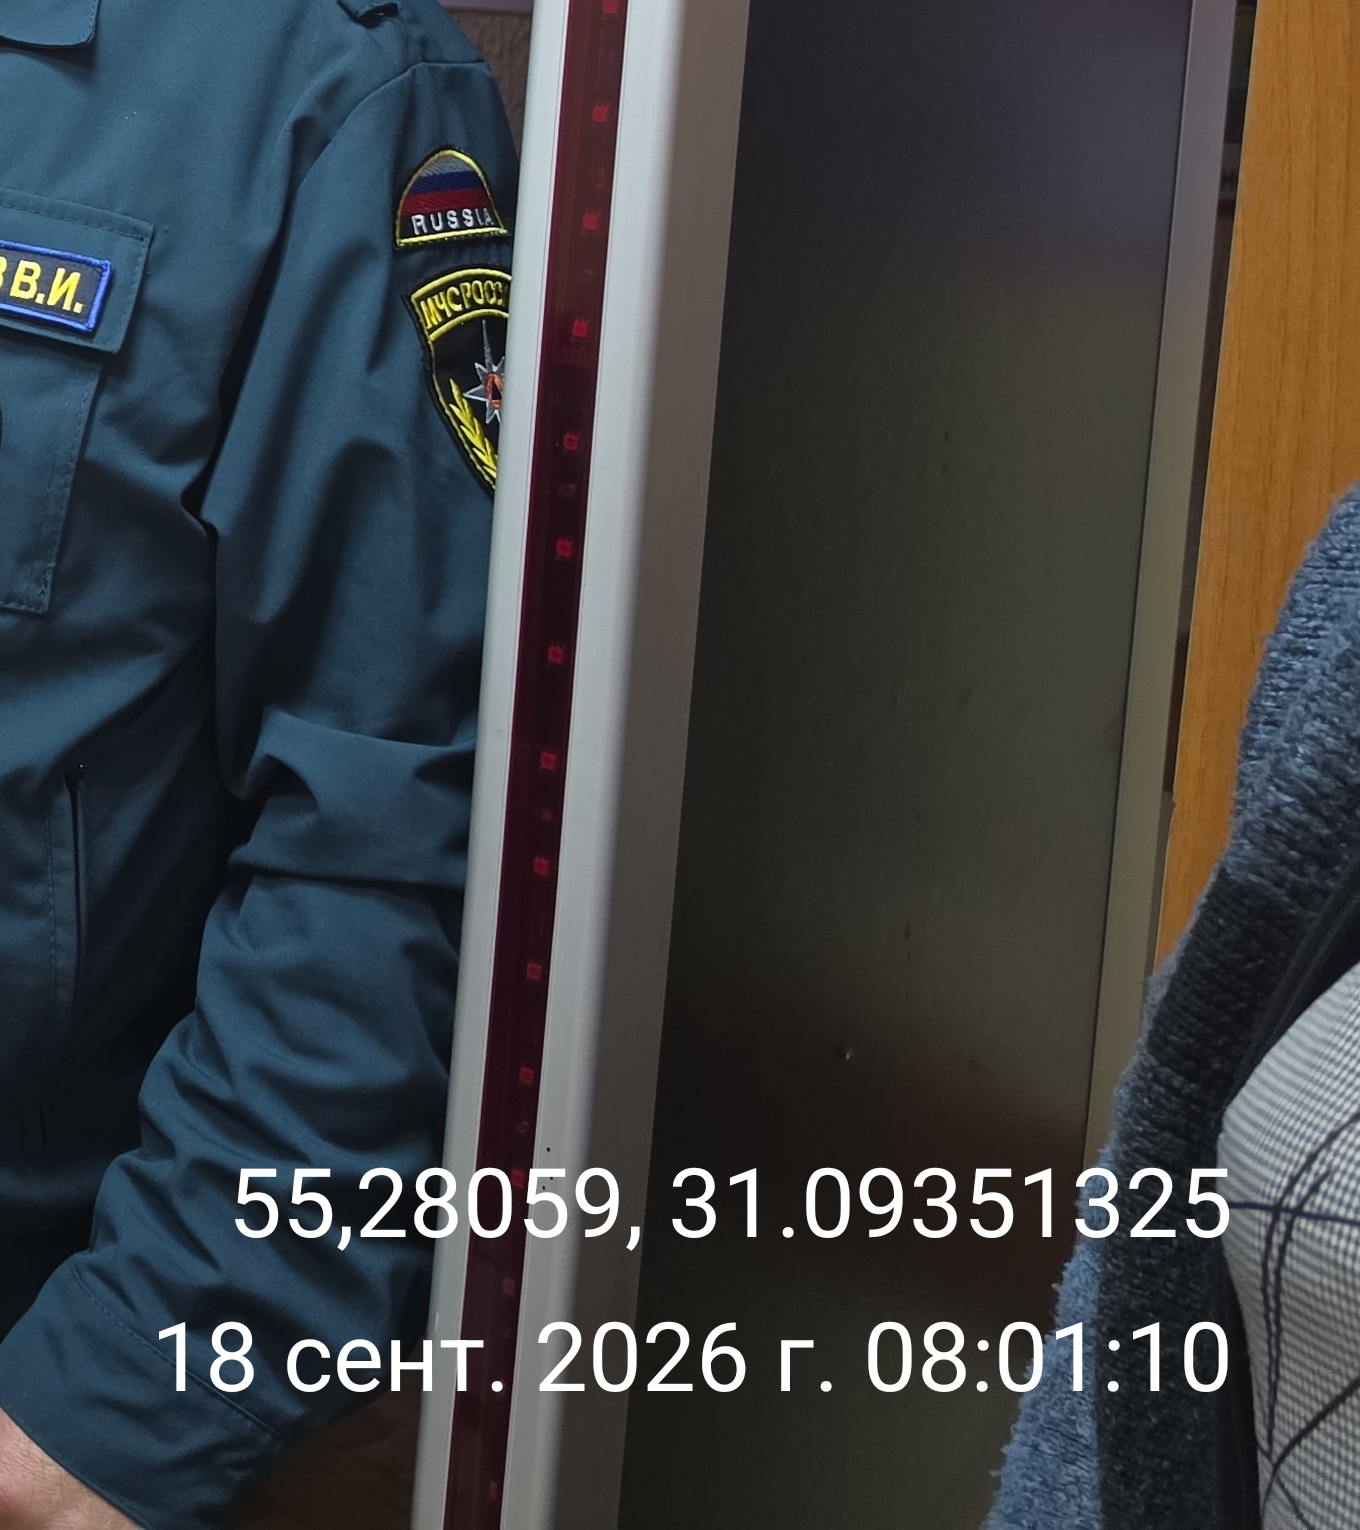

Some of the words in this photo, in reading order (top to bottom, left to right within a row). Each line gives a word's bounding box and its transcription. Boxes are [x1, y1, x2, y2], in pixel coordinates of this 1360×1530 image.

[411, 208, 495, 236] RUSSIA
[10, 259, 84, 313] В.И.
[420, 286, 463, 330] МЧС
[460, 280, 509, 310] РОСС
